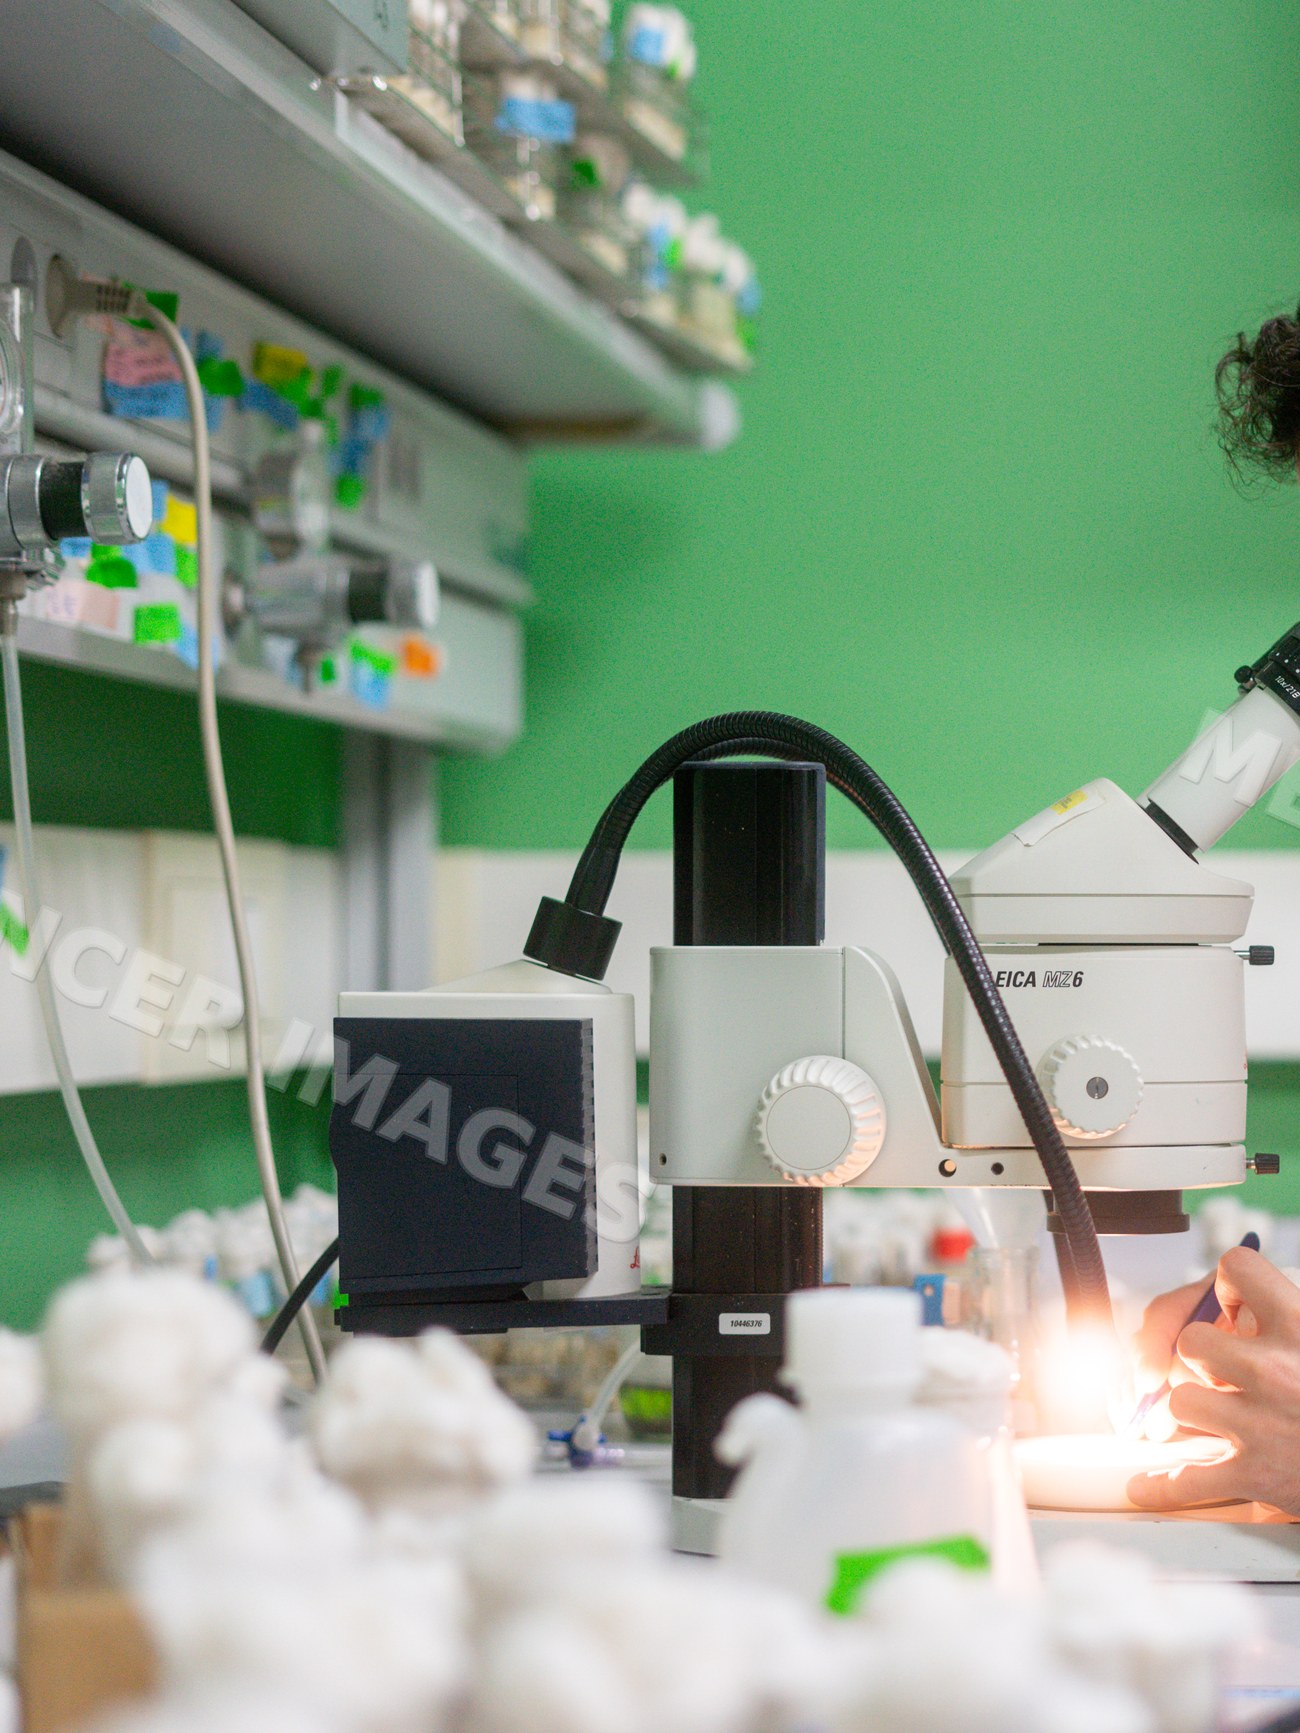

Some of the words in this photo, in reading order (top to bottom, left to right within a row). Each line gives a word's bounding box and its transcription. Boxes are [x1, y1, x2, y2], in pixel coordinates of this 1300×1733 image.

[1275, 675, 1300, 699] 10x/21B
[991, 971, 1036, 988] EICA
[1042, 970, 1084, 988] MZ6
[730, 1320, 762, 1328] 10446376
